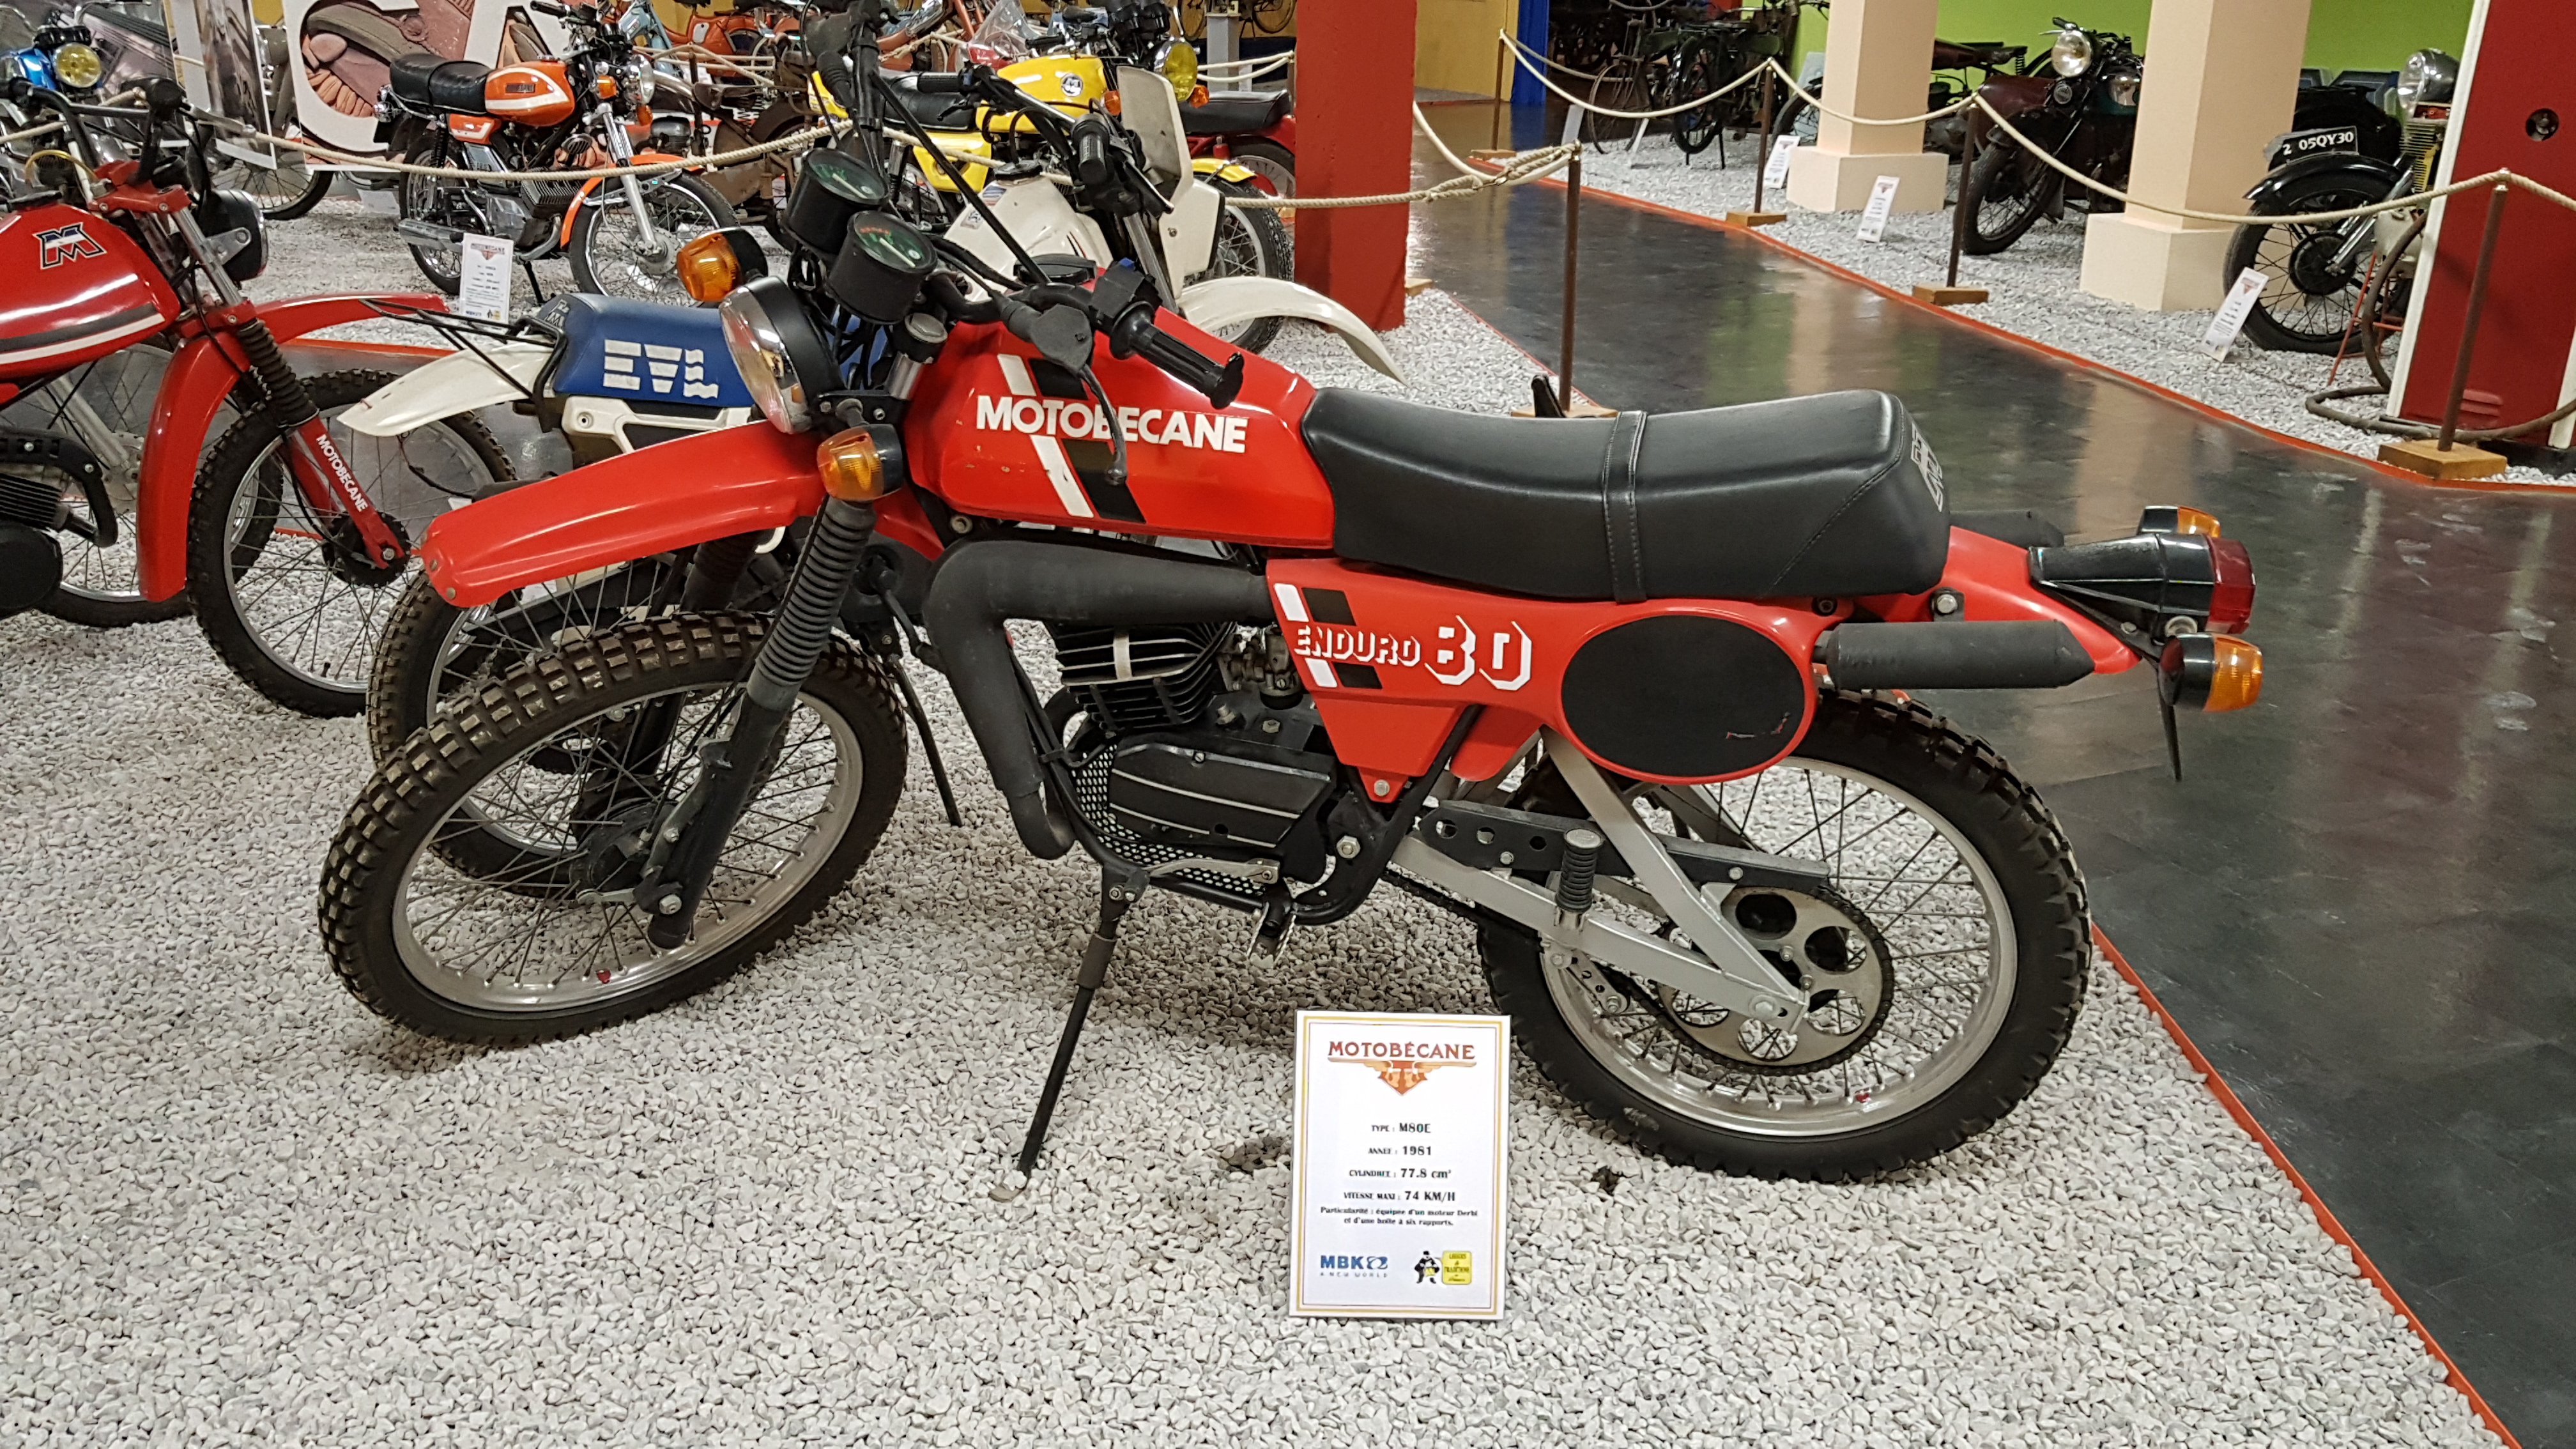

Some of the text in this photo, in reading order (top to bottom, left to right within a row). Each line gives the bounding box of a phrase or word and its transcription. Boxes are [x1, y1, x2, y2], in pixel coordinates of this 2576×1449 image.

[2282, 131, 2354, 156] 2 05QY30
[602, 339, 719, 399] EVL
[976, 395, 1249, 454] MOTOBECANE
[316, 434, 369, 512] MOTOBECANE
[1294, 615, 1532, 691] ENDURO 80
[1327, 1041, 1476, 1060] MOTOBÉCANE
[1399, 1123, 1432, 1133] M80E
[1402, 1146, 1432, 1156] 1981
[1400, 1168, 1427, 1178] 77.8
[1343, 1192, 1374, 1200] VITESSE
[1404, 1190, 1419, 1200] 74
[1424, 1191, 1456, 1202] KM/H
[1320, 1255, 1365, 1269] MBK
